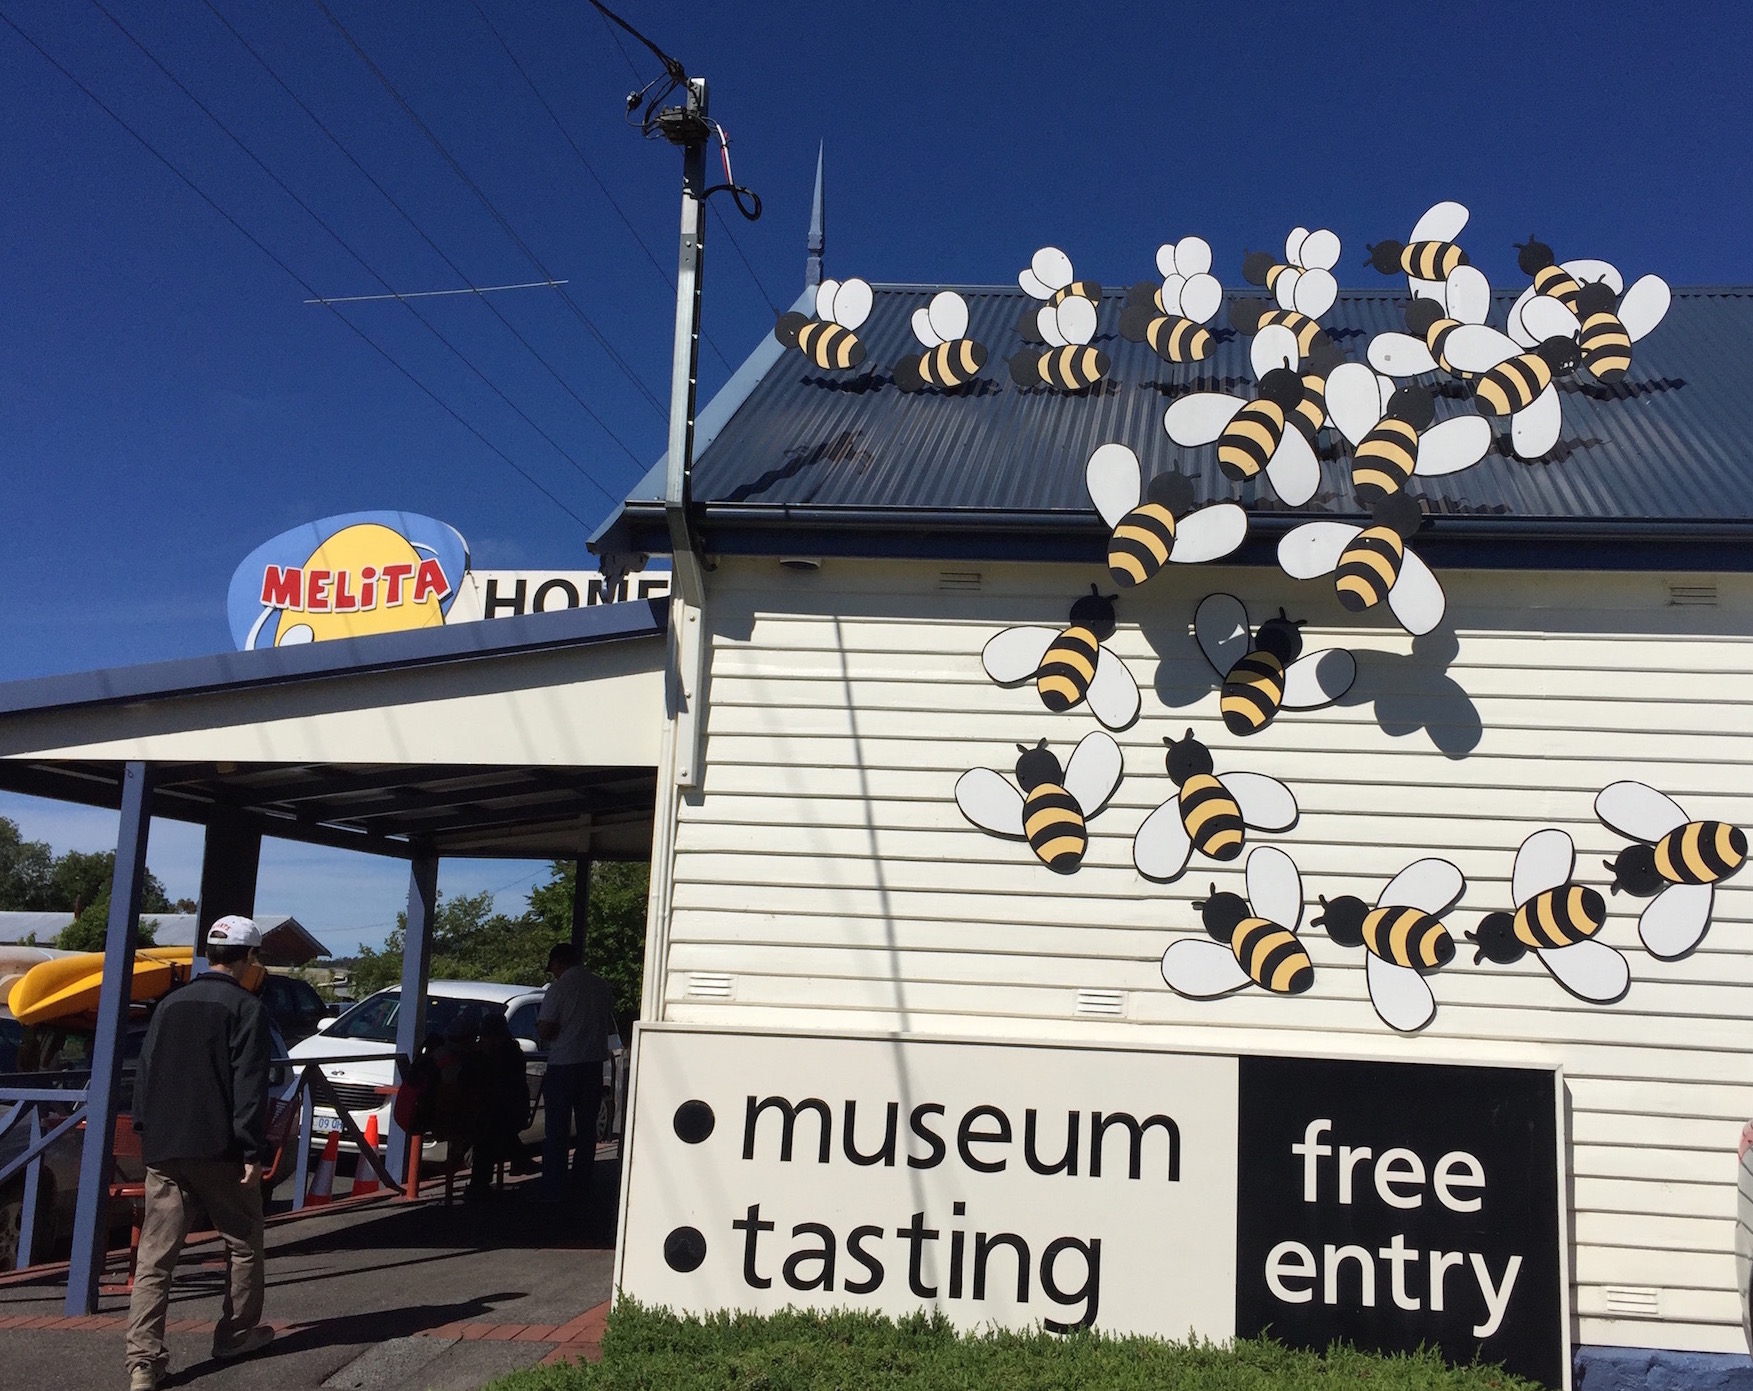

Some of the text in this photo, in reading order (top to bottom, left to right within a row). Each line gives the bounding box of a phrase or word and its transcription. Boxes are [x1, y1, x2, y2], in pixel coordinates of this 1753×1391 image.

[742, 1094, 1181, 1182] museum
[1291, 1119, 1487, 1213] free
[732, 1201, 1102, 1334] tasting
[1264, 1234, 1523, 1338] entry
